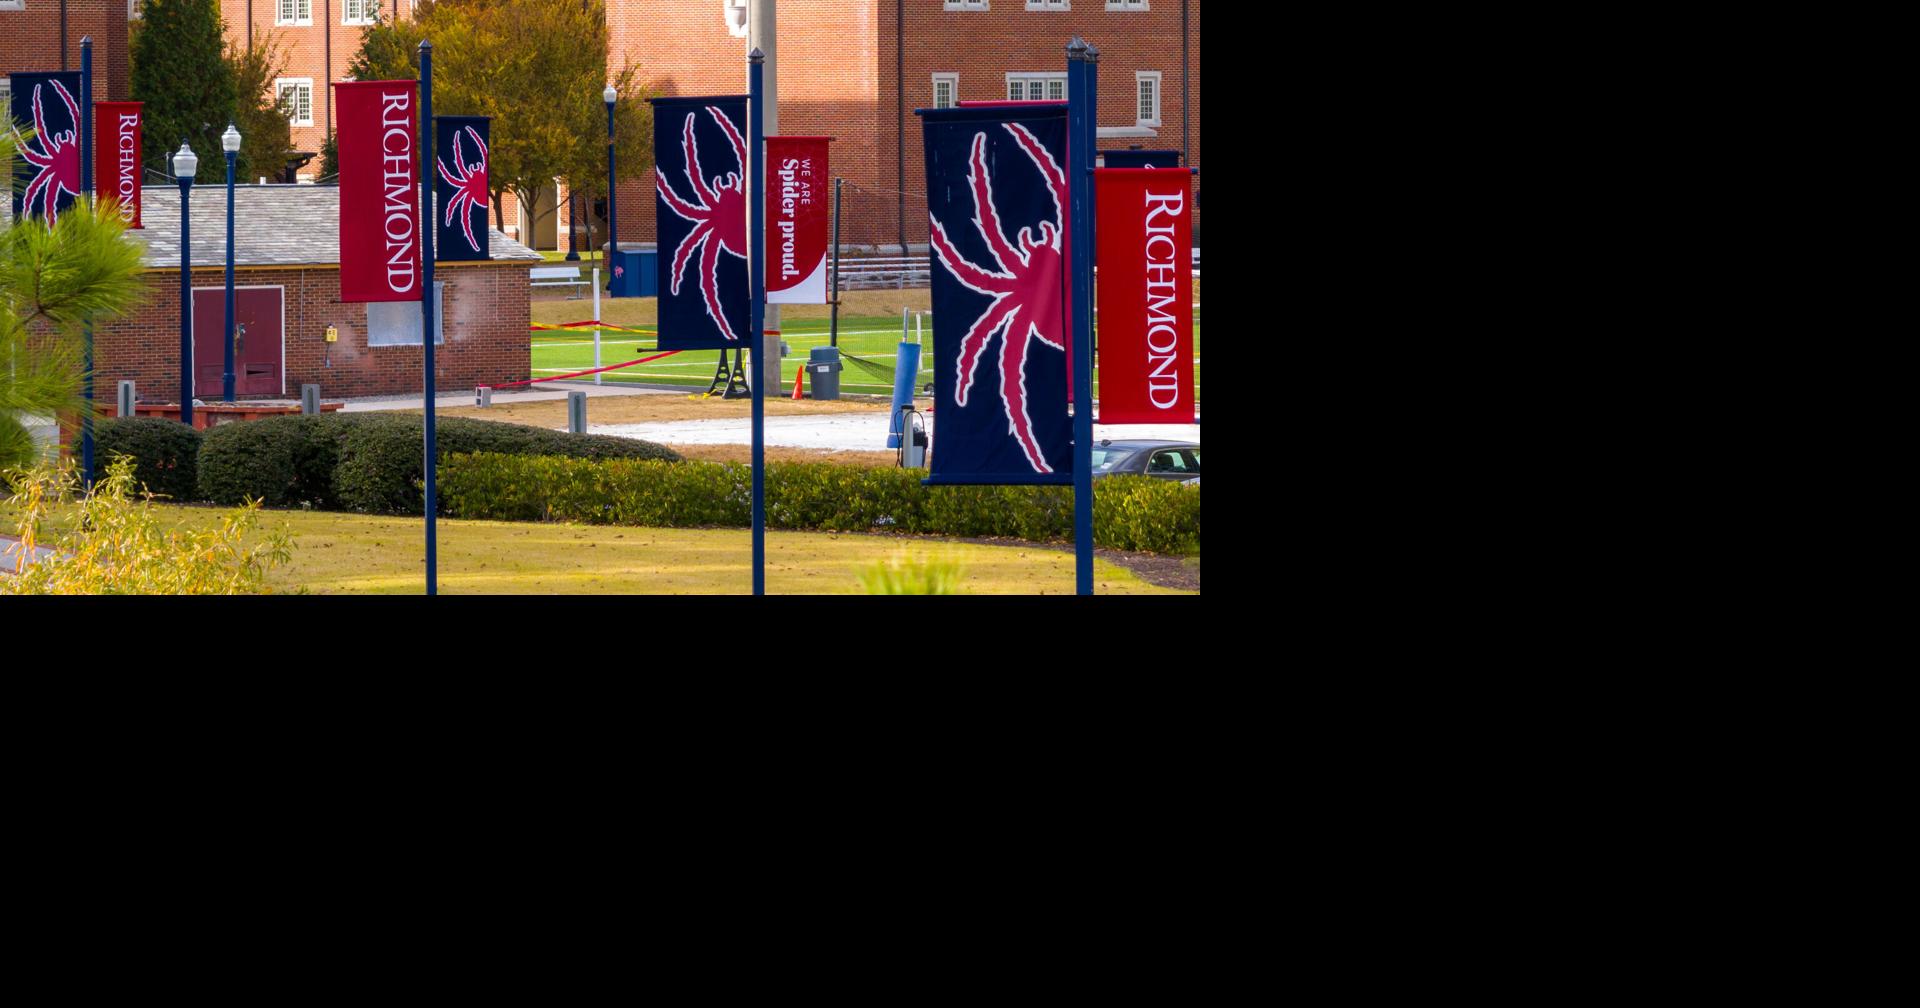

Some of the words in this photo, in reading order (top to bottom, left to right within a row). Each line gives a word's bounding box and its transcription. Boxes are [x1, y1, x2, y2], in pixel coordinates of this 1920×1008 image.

[119, 113, 138, 222] RICHMOND
[382, 91, 415, 293] RICHMOND
[778, 158, 800, 217] Spider
[801, 158, 811, 177] WE
[801, 182, 811, 205] ARE
[777, 221, 800, 281] proud.
[1145, 189, 1184, 409] RICHMOND
